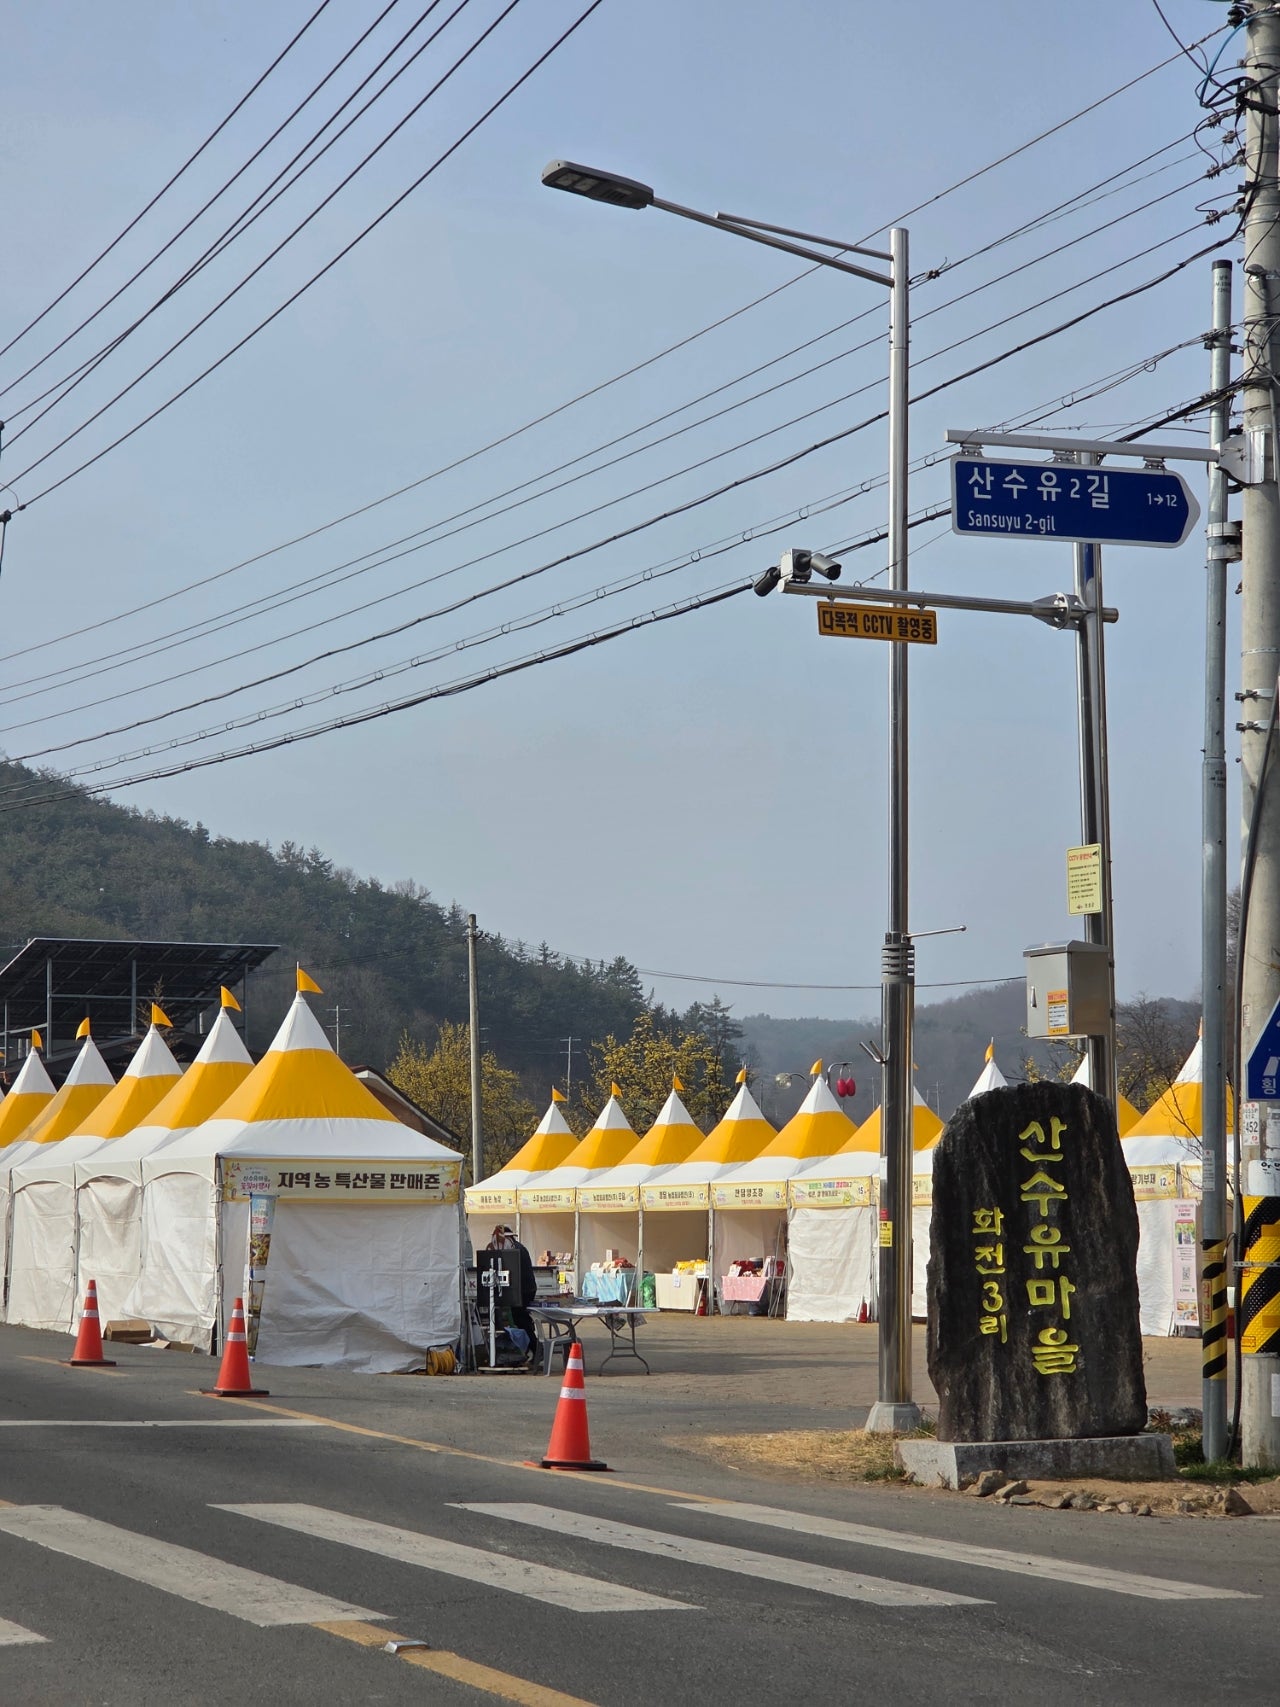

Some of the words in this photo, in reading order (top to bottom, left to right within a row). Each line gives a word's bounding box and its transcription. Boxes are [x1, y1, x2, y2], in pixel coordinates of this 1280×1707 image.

[968, 510, 1021, 532] Sansuyu
[1025, 513, 1056, 535] 2-gil
[822, 610, 858, 633] 다목적
[863, 613, 893, 635] CCTV
[897, 616, 933, 640] 촬영중
[277, 1172, 311, 1188] 지역
[334, 1172, 386, 1189] 특산물
[1159, 1177, 1167, 1187] 12
[1018, 1115, 1079, 1376] 산수유마을
[971, 1205, 1009, 1344] 화전3리
